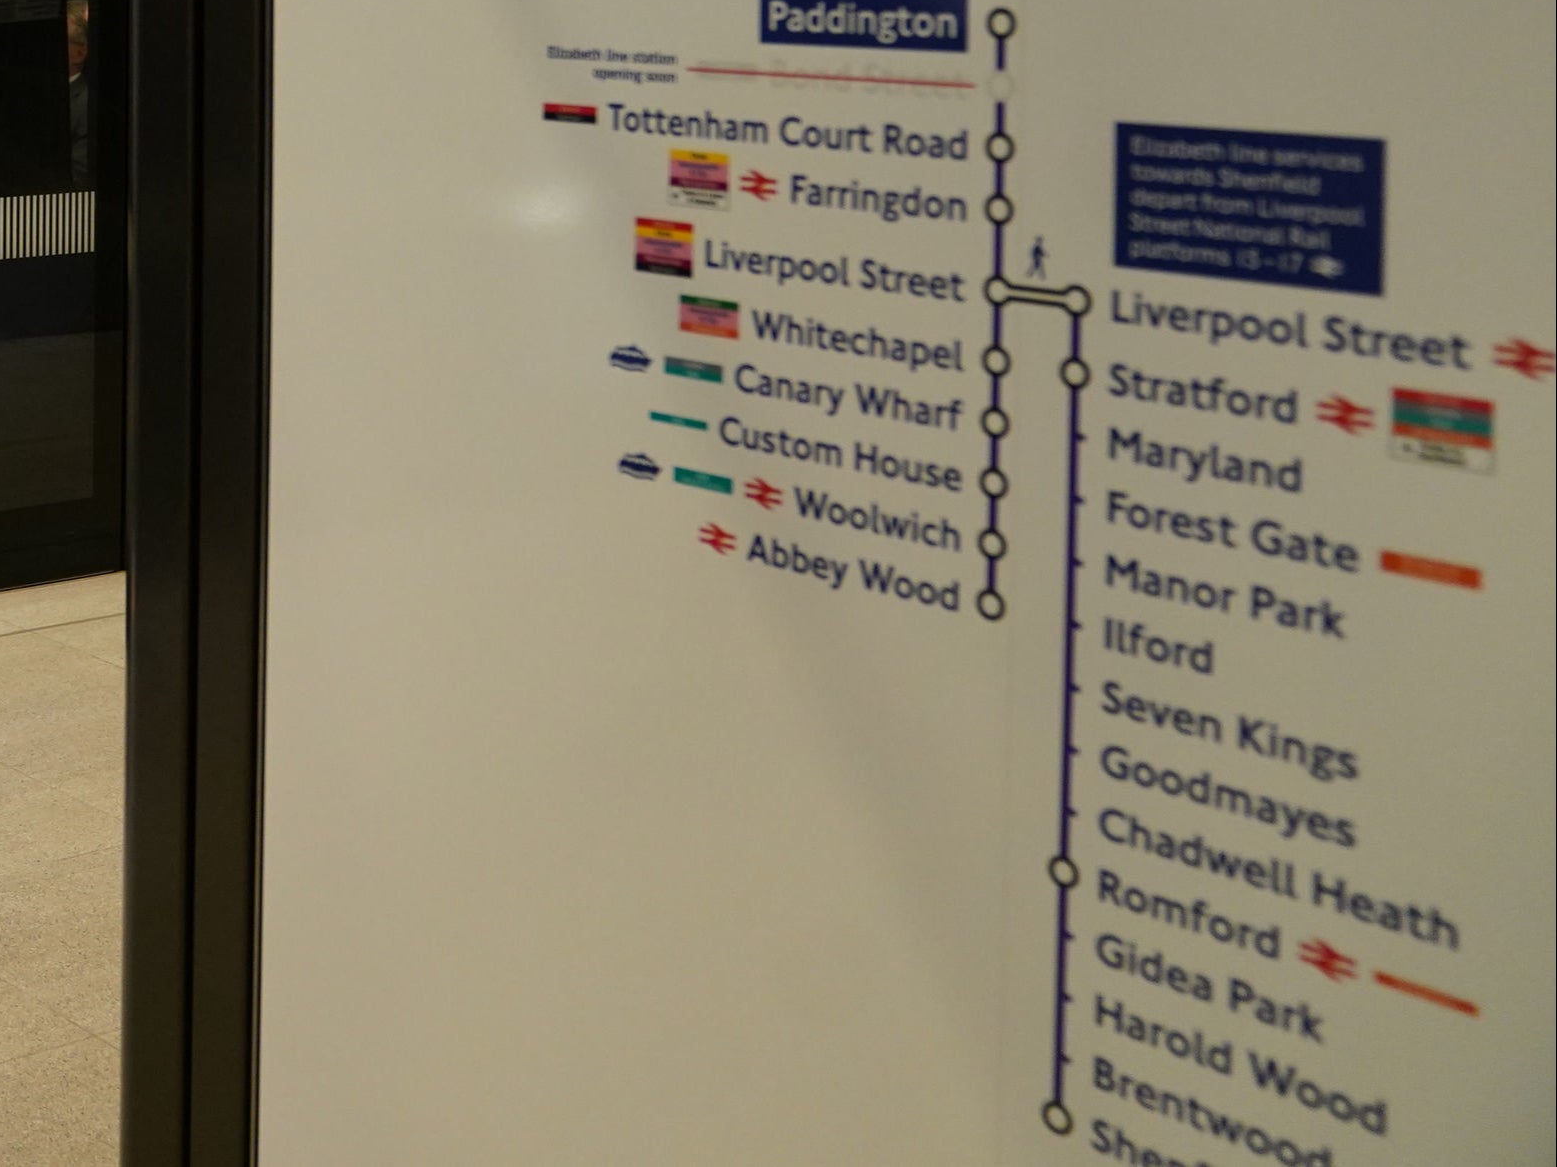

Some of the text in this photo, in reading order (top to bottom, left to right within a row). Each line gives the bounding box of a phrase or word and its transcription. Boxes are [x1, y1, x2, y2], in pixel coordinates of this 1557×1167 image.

[768, 0, 959, 43] Paddington
[609, 103, 769, 144] Tottenham
[780, 116, 873, 153] Court
[884, 124, 968, 160] Road
[790, 175, 967, 222] Farringdon
[705, 239, 849, 288] Liverpool
[862, 259, 966, 302] Street
[753, 310, 963, 371] Whitechapel
[1111, 290, 1473, 371] Liverpool Street
[735, 365, 844, 417] Canary
[857, 384, 963, 431] Wharf
[1108, 364, 1298, 424] Stratford
[719, 417, 963, 492] Custom House
[1107, 429, 1303, 492] Maryland
[795, 487, 961, 552] Woolwich
[1107, 491, 1238, 548] Forest
[1251, 520, 1361, 572] Gate
[747, 535, 959, 612] Abbey Wood
[1105, 555, 1345, 638] Manor Park
[1103, 618, 1215, 675] Ilford
[1101, 681, 1360, 782] Seven Kings
[1100, 746, 1356, 848] Goodmayes
[1097, 869, 1283, 960] Romford
[1098, 808, 1461, 950] Chadwell Heath
[1095, 933, 1324, 1045] Gidea Park
[1093, 994, 1388, 1136] Harold Wood
[1092, 1055, 1334, 1167] Brentwood
